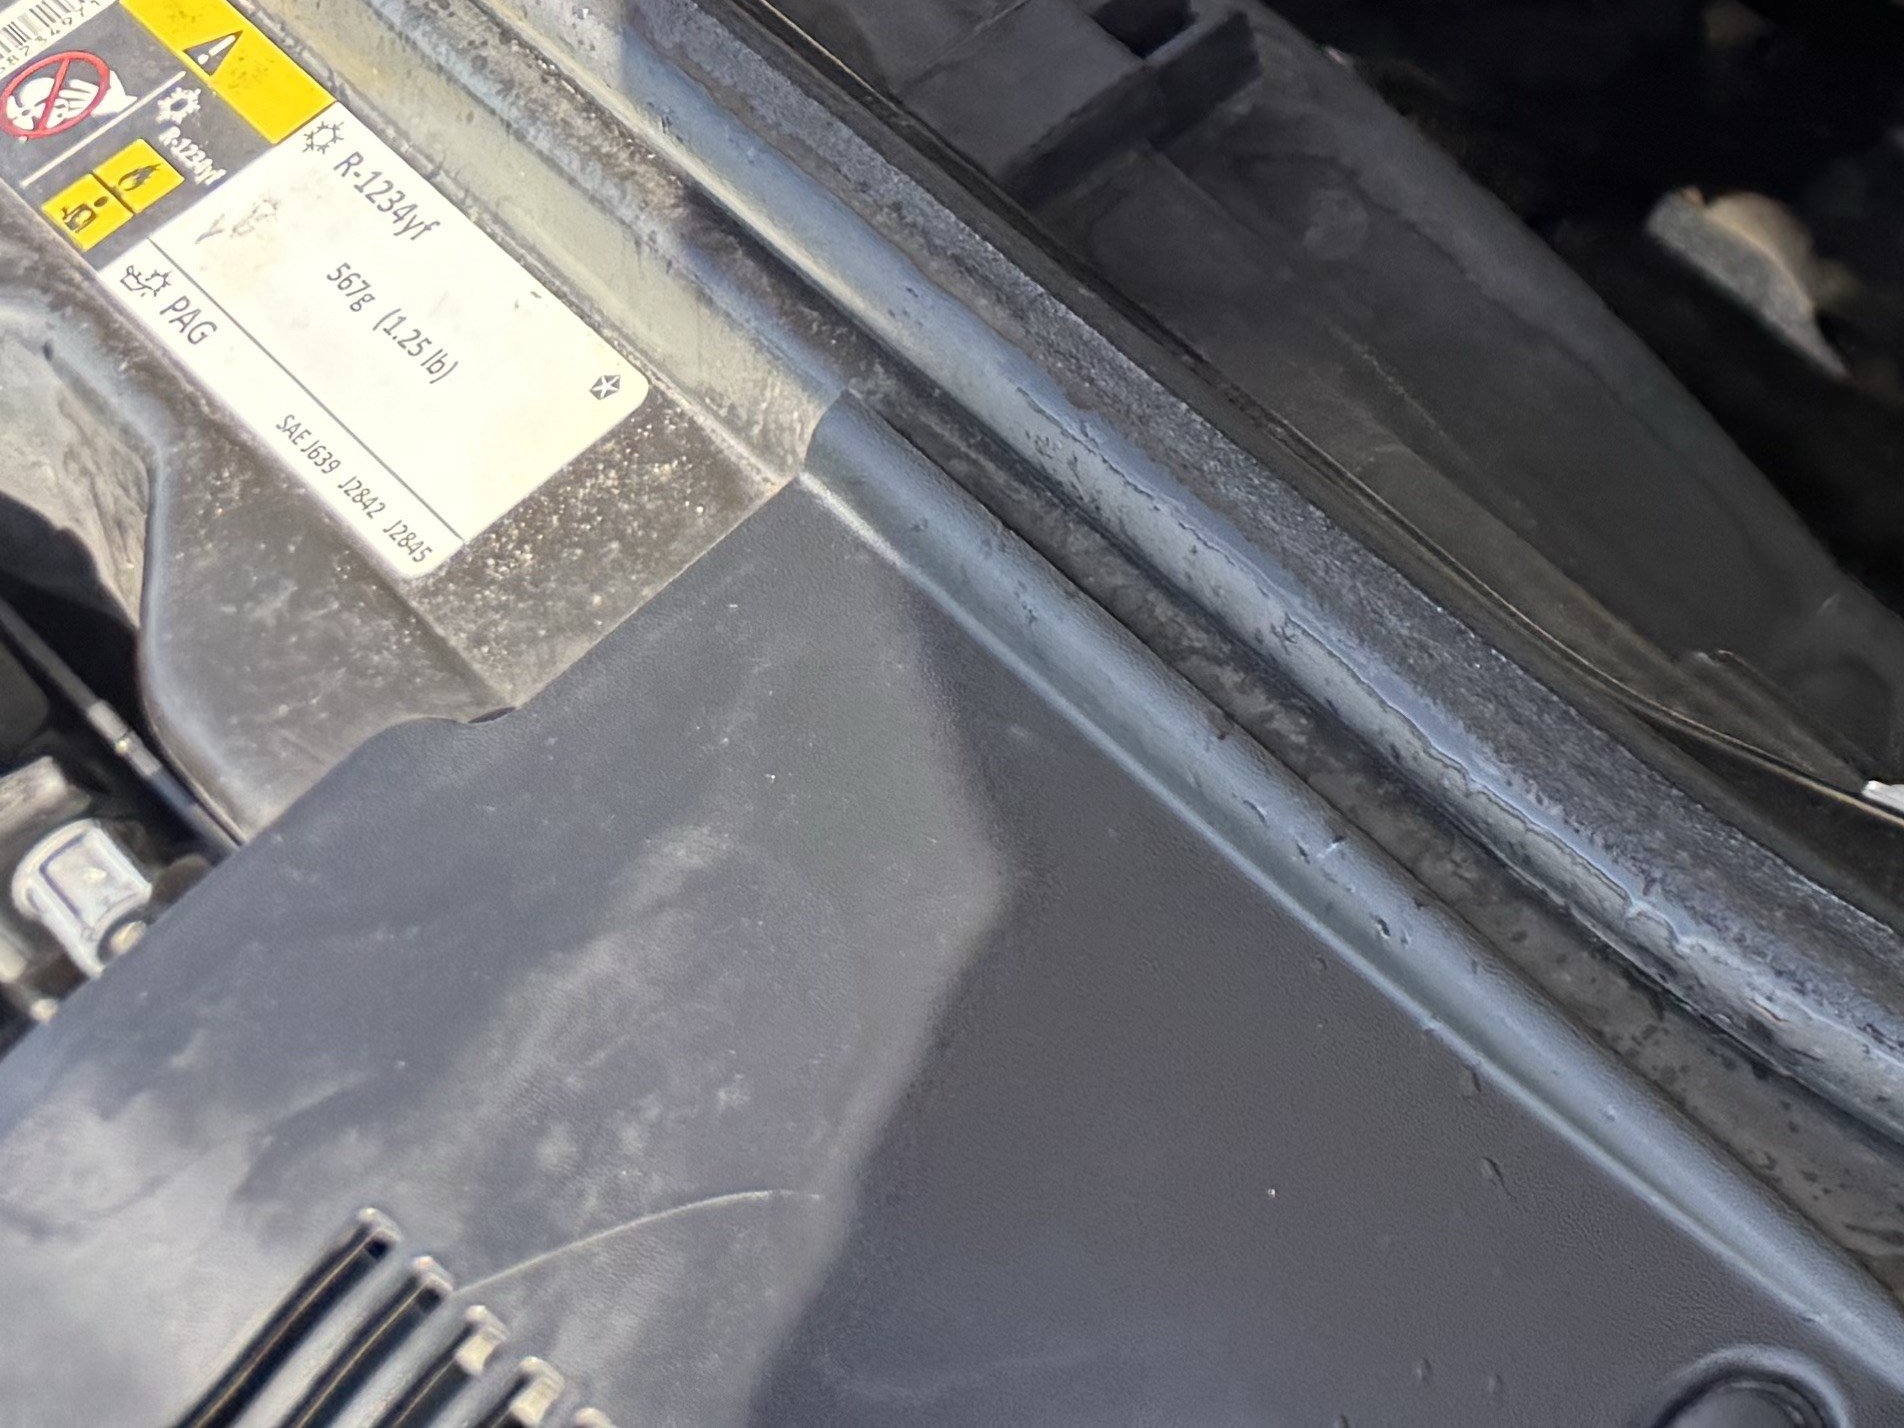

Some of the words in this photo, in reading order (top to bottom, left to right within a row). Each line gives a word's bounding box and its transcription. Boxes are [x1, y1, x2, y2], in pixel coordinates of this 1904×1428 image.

[332, 150, 441, 241] R-1234yf
[159, 295, 218, 345] PAG
[326, 261, 376, 313] 567g
[275, 413, 312, 446] SAE
[300, 439, 342, 475] J639
[337, 475, 386, 520] J2842
[382, 519, 433, 563] J2845
